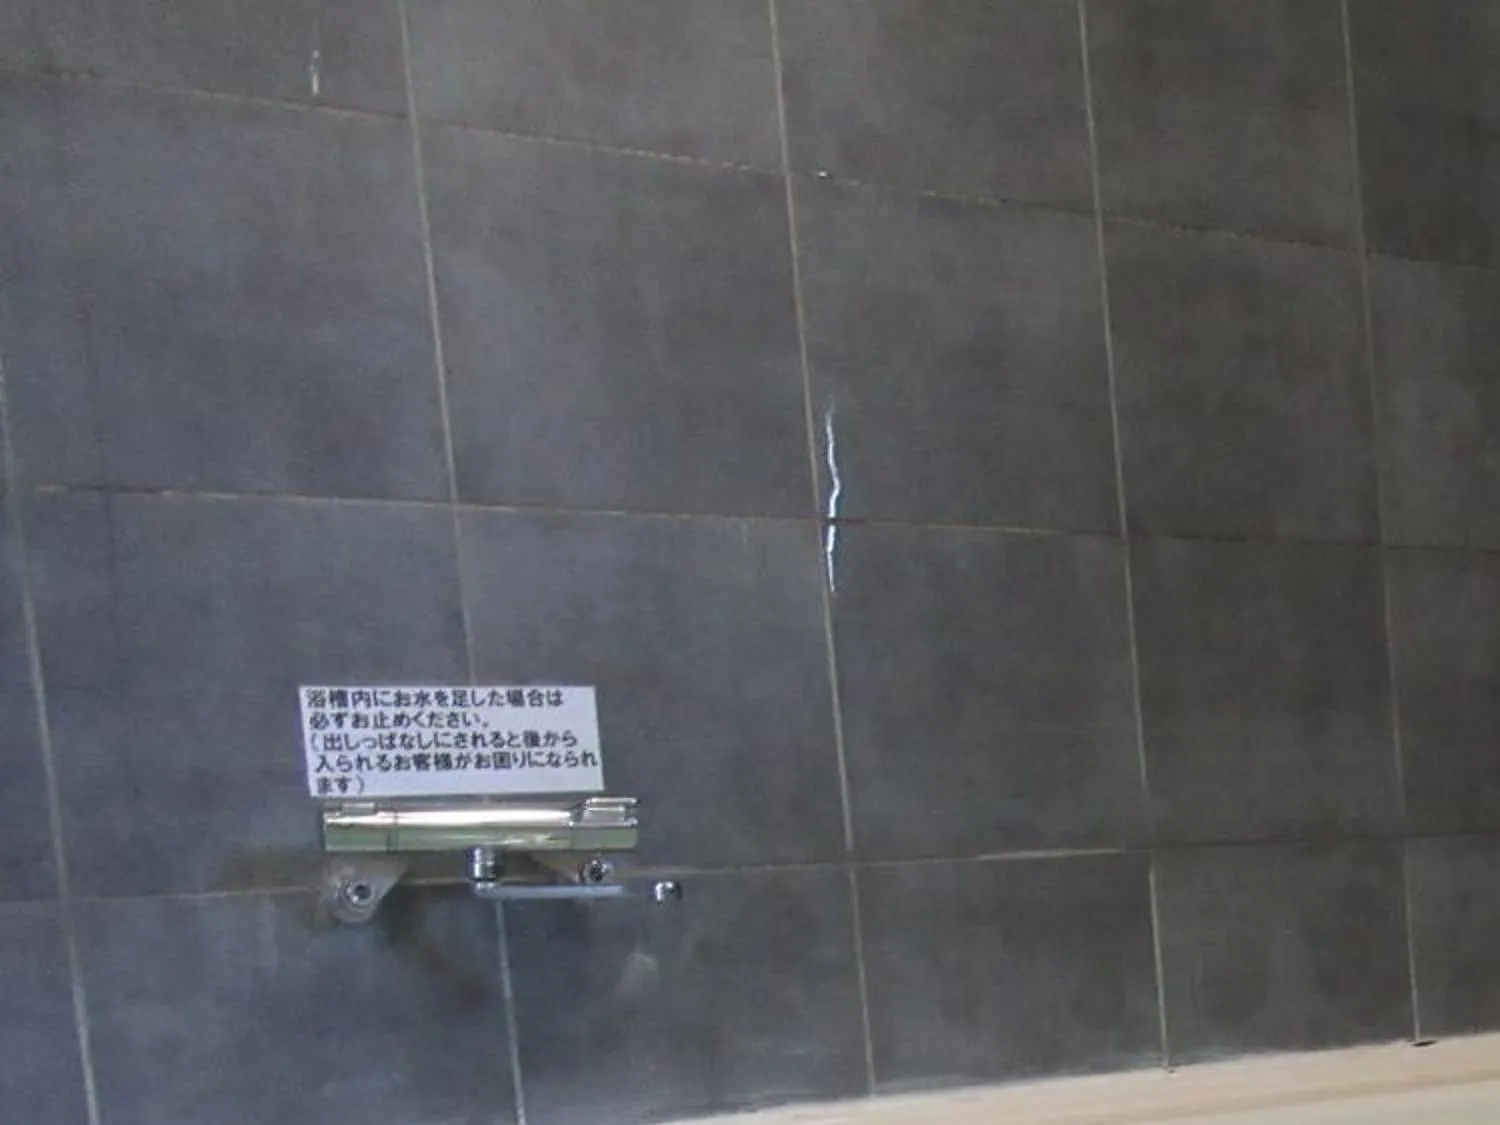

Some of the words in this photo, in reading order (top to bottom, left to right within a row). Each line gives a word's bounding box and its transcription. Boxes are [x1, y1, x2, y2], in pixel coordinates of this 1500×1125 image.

[305, 687, 565, 710] 浴槽内にお水を足した場合は
[308, 710, 491, 731] 必ずお止めください。
[314, 750, 599, 774] 入られるお客様がお困りになられ
